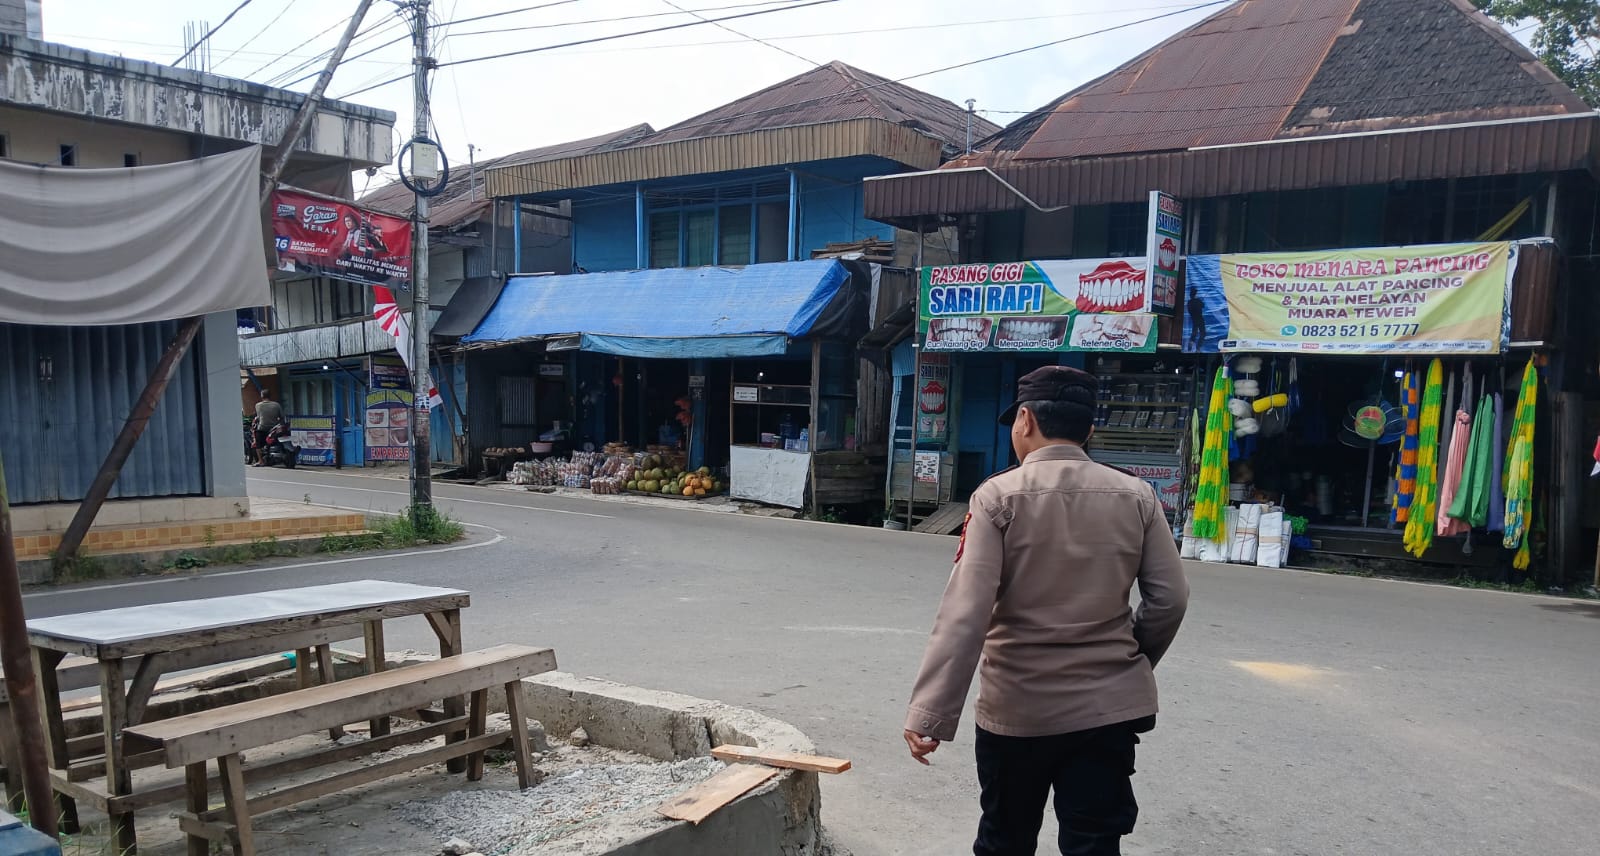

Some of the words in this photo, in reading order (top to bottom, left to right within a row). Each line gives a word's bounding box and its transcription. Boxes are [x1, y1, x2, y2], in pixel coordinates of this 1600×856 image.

[304, 223, 337, 235] MERAH
[275, 238, 288, 249] 16
[351, 255, 380, 267] KUALITAS
[353, 263, 375, 272] WAKTU
[1236, 263, 1289, 279] TOKO
[1294, 258, 1388, 278] MENARA
[1395, 253, 1489, 275] PANCING
[931, 265, 988, 284] PASANG
[991, 263, 1024, 282] GIGI
[1252, 282, 1328, 293] MENJUAL
[1333, 281, 1378, 292] ALAT
[1382, 277, 1463, 290] PANCING
[930, 286, 982, 314] SARI
[985, 284, 1043, 313] RAPI
[1281, 295, 1292, 306] &
[1297, 295, 1340, 305] ALAT
[1345, 293, 1426, 304] NELAYAN
[1288, 308, 1348, 319] MUARA
[1353, 306, 1417, 318] TEWEH
[1302, 325, 1336, 337] 0823
[1383, 323, 1420, 336] 7777
[970, 340, 986, 349] Gigi
[1000, 339, 1040, 349] Merapikan
[1041, 339, 1057, 349] Gigi
[1115, 339, 1132, 349] Gigi
[371, 447, 409, 460] EXPRESS
